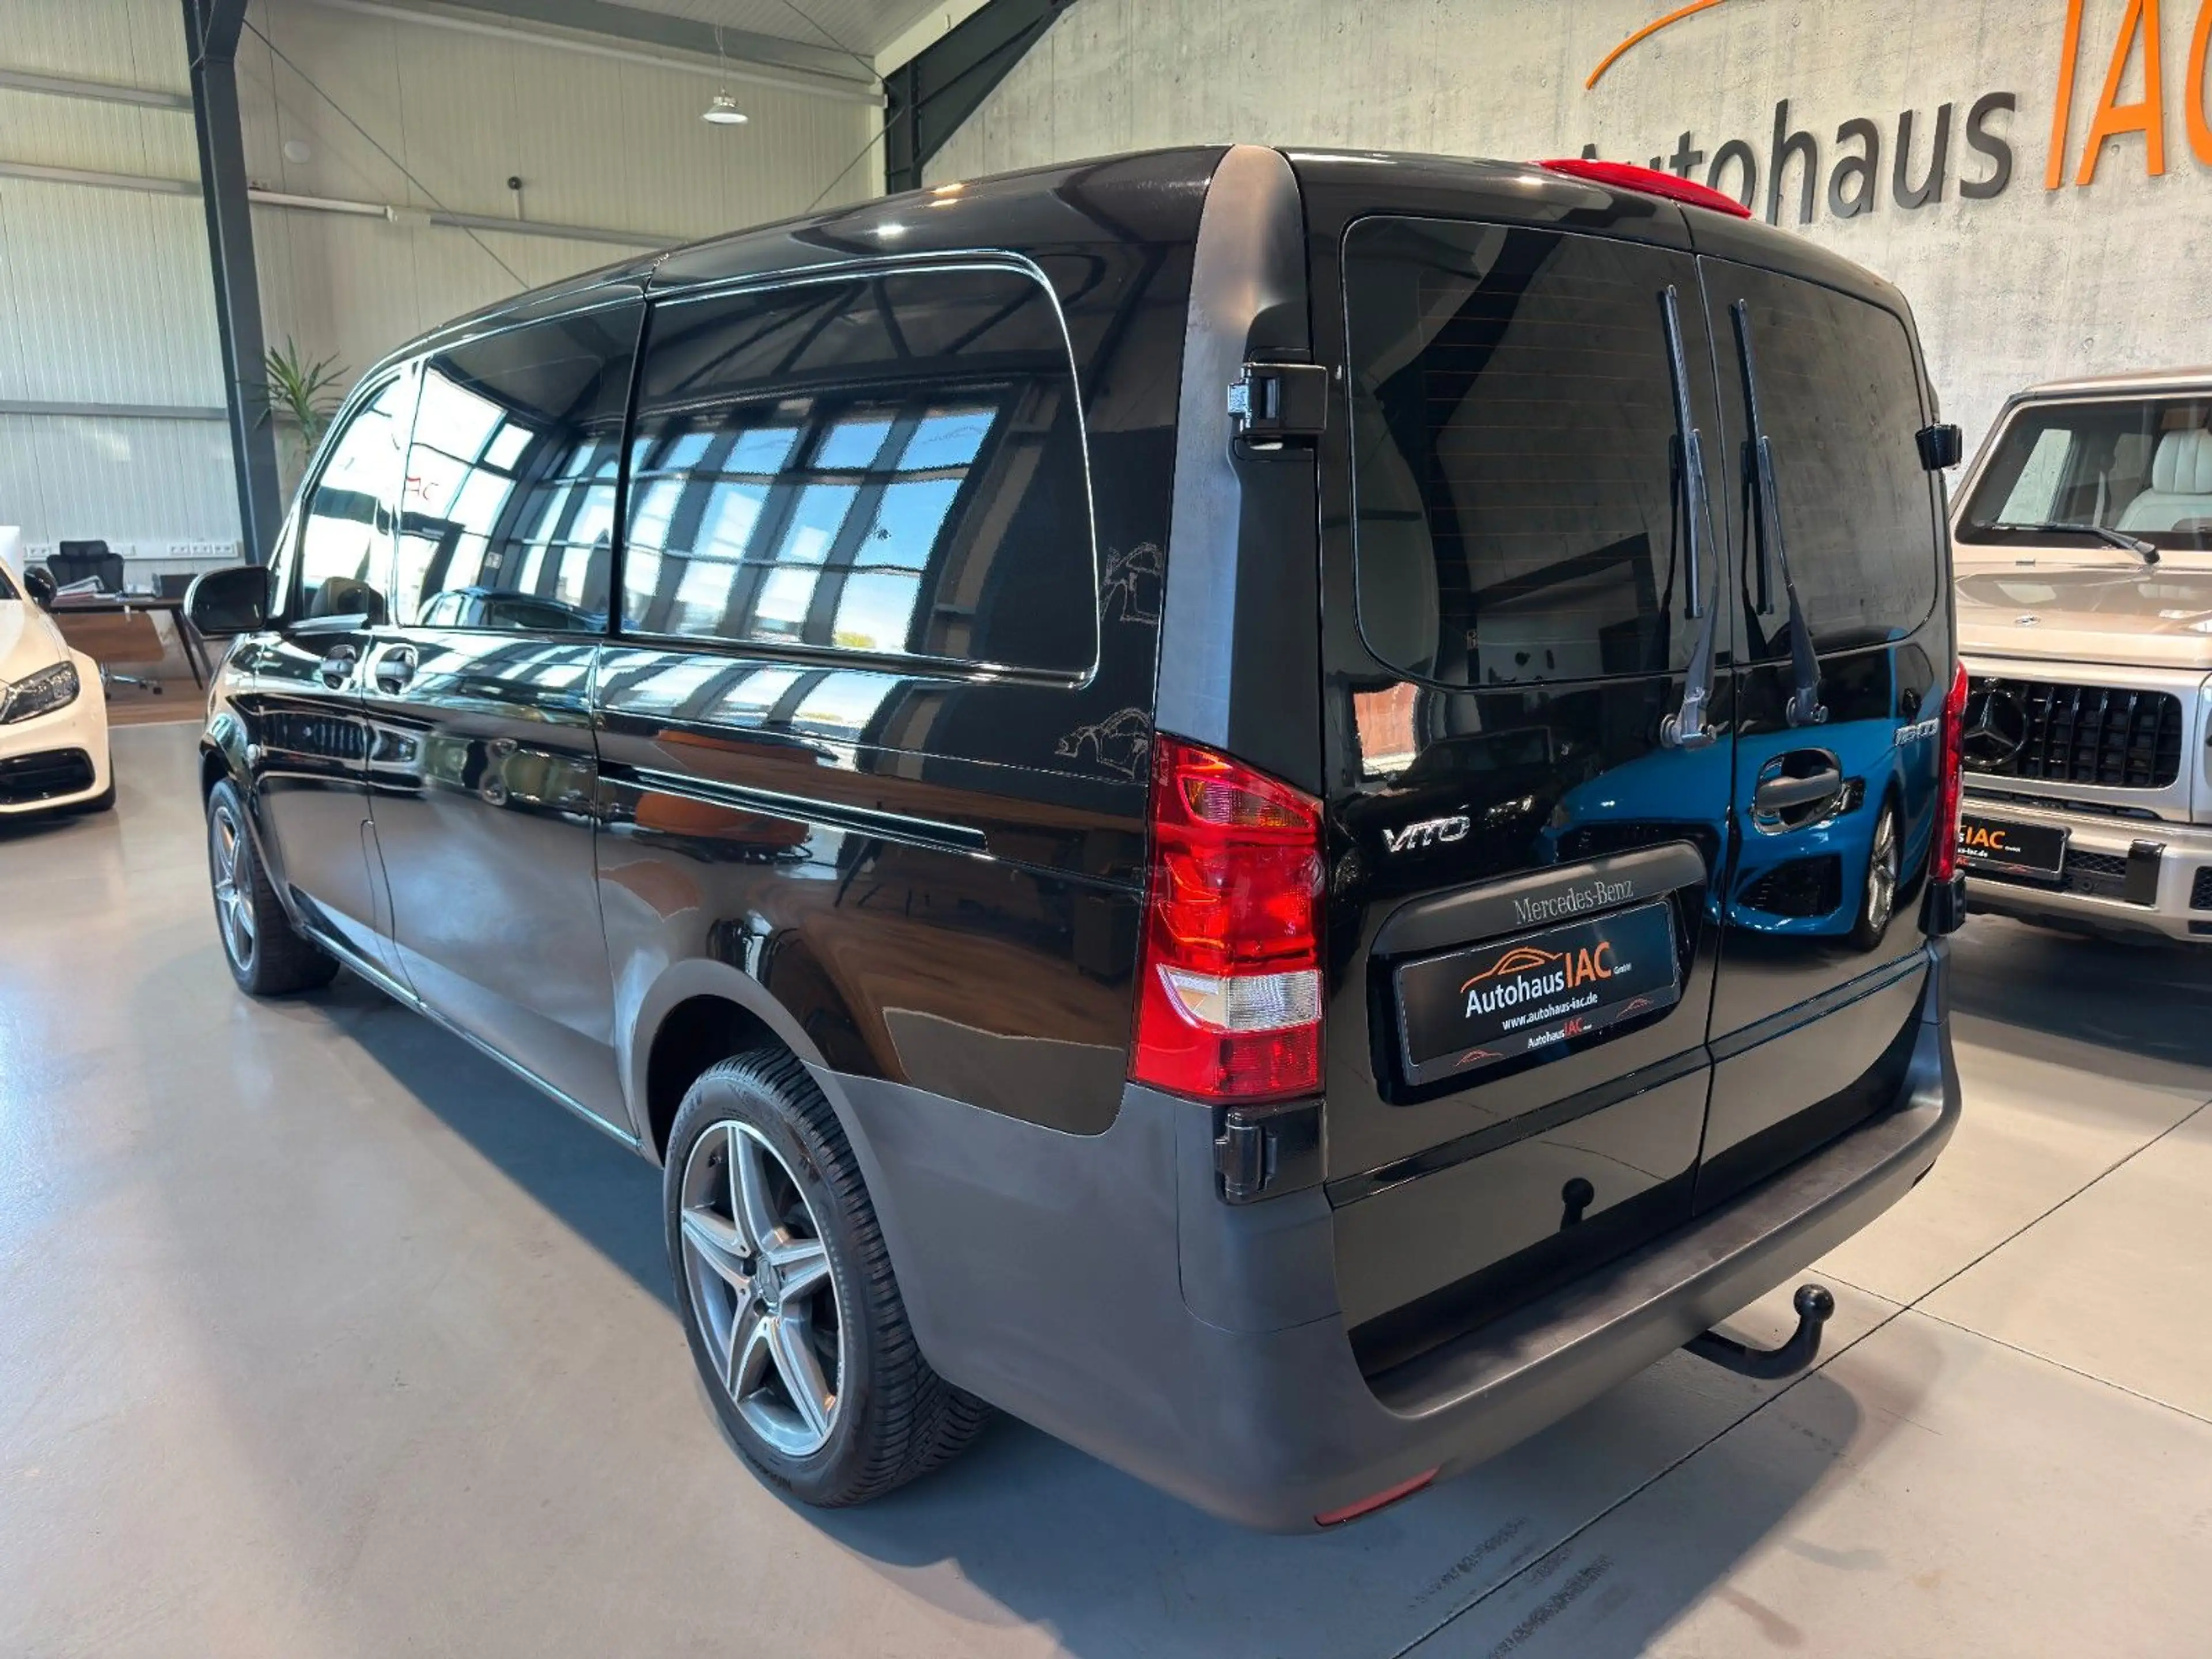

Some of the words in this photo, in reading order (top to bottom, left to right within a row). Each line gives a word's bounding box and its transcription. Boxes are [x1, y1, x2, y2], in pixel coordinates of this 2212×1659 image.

[1382, 816, 1470, 853] VITO
[1965, 827, 2005, 849] IAC
[1513, 880, 1634, 925] Mercedes-Benz
[1465, 971, 1565, 1018] Autohaus
[1565, 941, 1612, 988] IAC
[1502, 991, 1598, 1031] www.autohaus-iac.de
